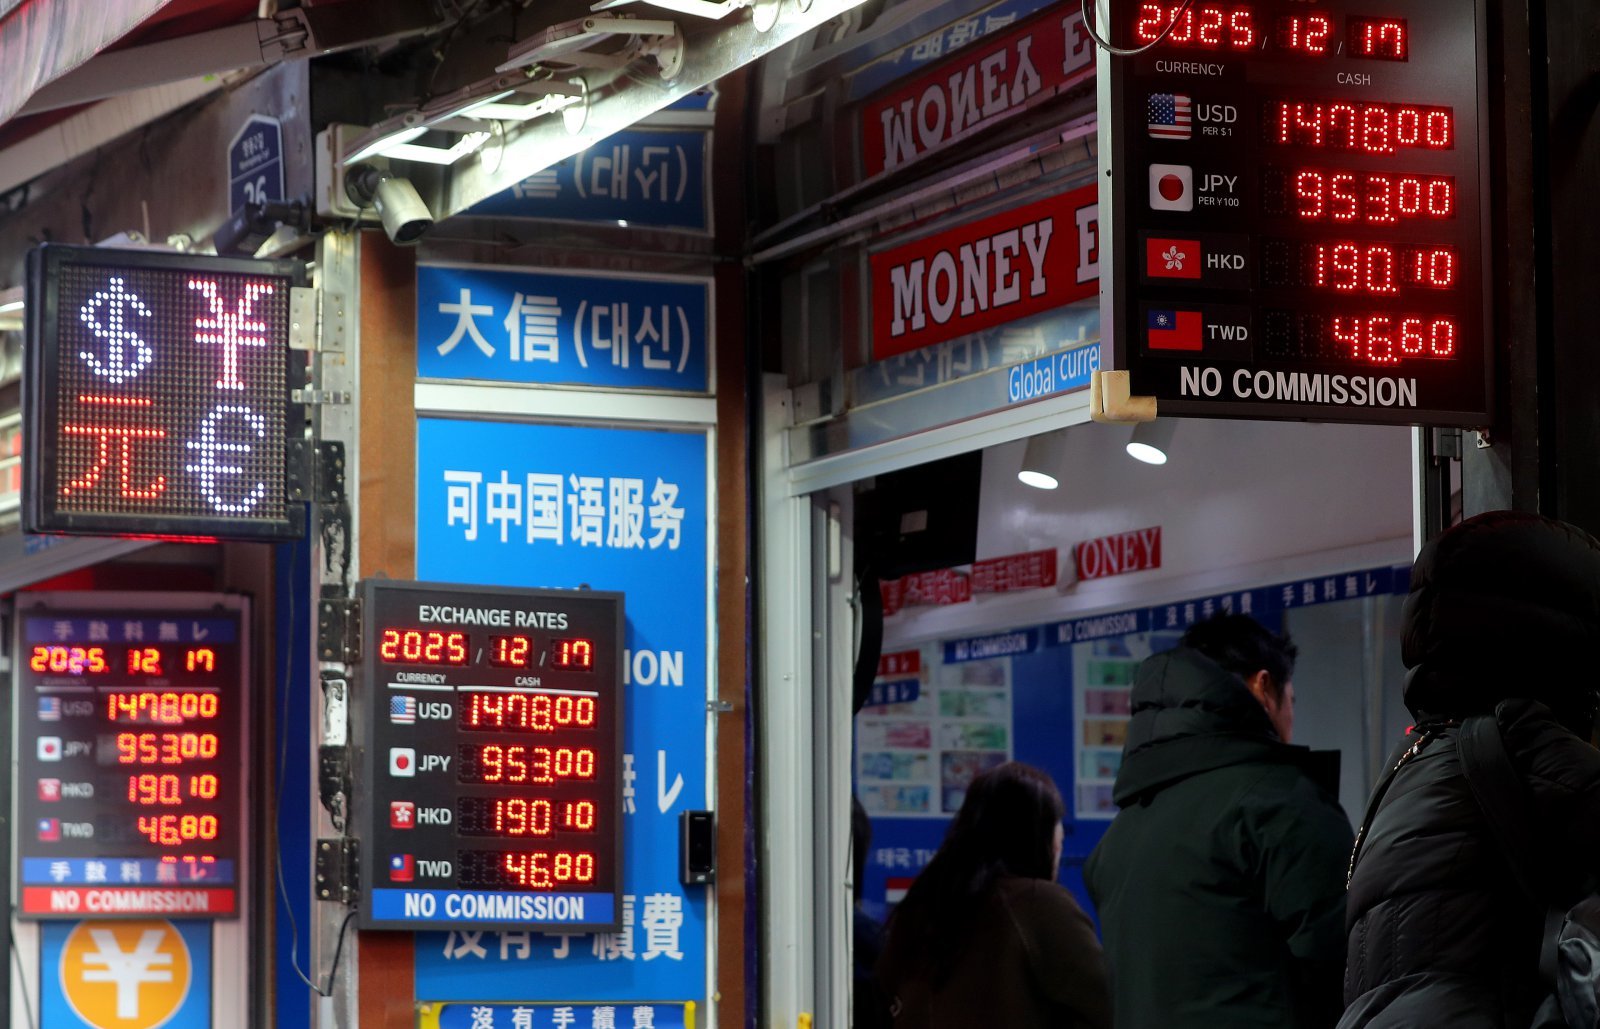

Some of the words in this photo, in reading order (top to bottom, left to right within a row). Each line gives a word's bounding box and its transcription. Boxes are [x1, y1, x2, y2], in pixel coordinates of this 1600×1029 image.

[1138, 4, 1252, 46] 2025
[1292, 17, 1328, 51] 12
[1366, 24, 1402, 54] 17
[1155, 60, 1225, 76] CURRENCY
[1336, 72, 1371, 86] CASH
[1197, 103, 1237, 123] USD
[1281, 103, 1449, 153] 1478.00
[1202, 126, 1219, 136] PER
[1198, 196, 1215, 206] PER
[1199, 174, 1238, 193] JPY
[1297, 171, 1450, 222] 953.00
[889, 217, 1053, 338] MONEY
[1206, 253, 1245, 271] HKD
[1317, 244, 1452, 292] 190.10
[1207, 324, 1248, 341] TWD
[1333, 316, 1453, 363] 46.60
[1009, 357, 1055, 402] Global
[1180, 365, 1223, 397] NO
[1232, 368, 1418, 407] COMMISSION
[443, 468, 686, 551] 可中国语服务
[419, 605, 511, 627] EXCHANGE
[514, 610, 569, 630] RATES
[1057, 623, 1073, 643] NO
[1074, 612, 1138, 641] COMMISSION
[30, 646, 105, 673] 2025
[131, 648, 161, 674] 12
[186, 648, 214, 672] 17
[380, 630, 465, 662] 2025
[500, 637, 528, 665] 12
[562, 640, 590, 665] 17
[954, 639, 970, 660] NO
[396, 671, 447, 684] CURRENCY
[514, 676, 541, 687] CASH
[418, 702, 452, 720] USD
[471, 694, 594, 731] 1478.00
[64, 741, 93, 756] JPY
[418, 755, 451, 773] JPY
[483, 745, 594, 783] 953.00
[61, 782, 94, 797] HKD
[61, 822, 94, 838] TWD
[417, 807, 452, 825] HKD
[417, 860, 452, 878] TWD
[506, 853, 594, 888] 46.80
[51, 890, 80, 911] NO
[85, 890, 209, 912] COMMISSION
[404, 892, 436, 917] NO
[445, 893, 585, 921] COMMISSION
